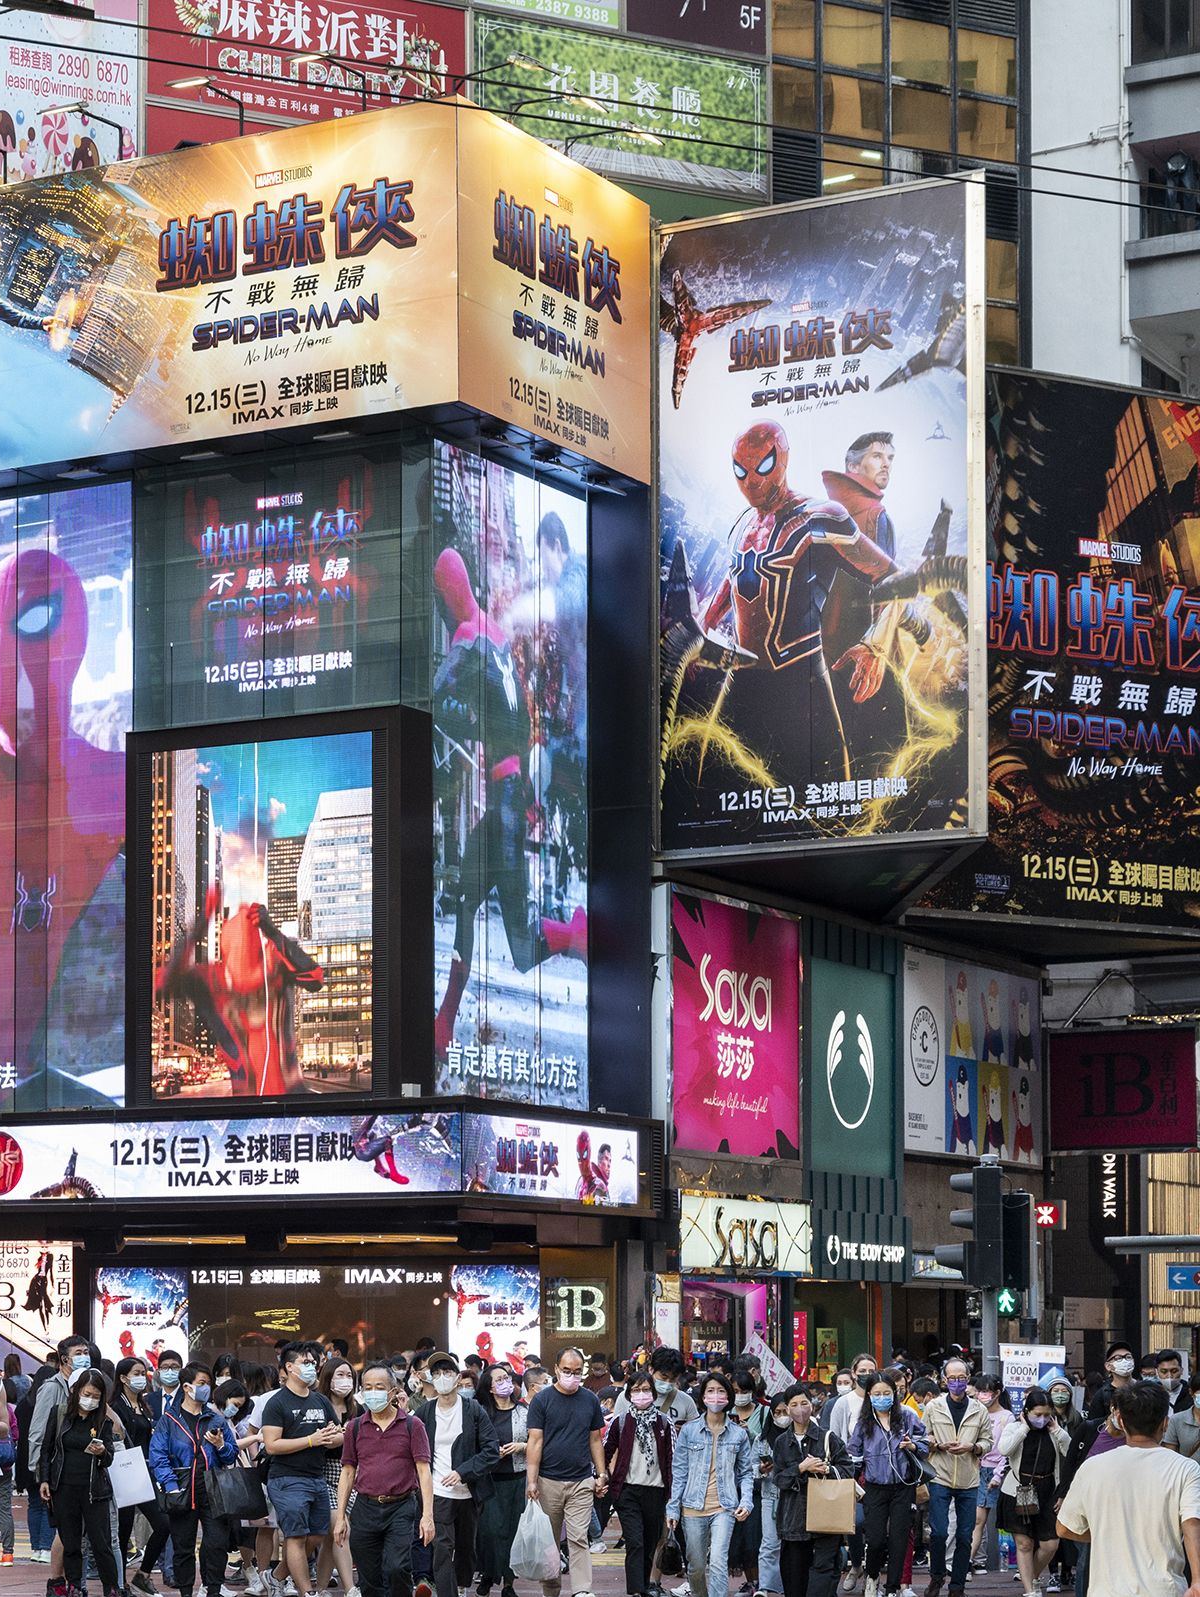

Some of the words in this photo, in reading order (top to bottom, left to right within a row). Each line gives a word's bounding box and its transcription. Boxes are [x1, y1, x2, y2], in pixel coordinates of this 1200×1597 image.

[536, 0, 570, 15] 2387
[575, 4, 609, 23] 9388
[740, 6, 762, 30] 5F
[217, 0, 409, 66] 麻辣派對
[9, 46, 52, 72] 租務查詢
[58, 54, 90, 79] 2890
[97, 62, 129, 85] 6870
[218, 47, 300, 88] CHILI
[307, 63, 407, 104] PARTY
[5, 71, 132, 107] leasing@winnings.com.hk
[726, 76, 749, 90] 4/F
[255, 171, 283, 189] MARVEL
[284, 165, 312, 183] STUDIOS
[156, 176, 419, 292] 蜘蛛俠
[492, 188, 622, 326] 蜘蛛俠
[204, 264, 367, 314] 不戰無歸
[519, 282, 599, 341] 不戰無歸
[244, 350, 260, 366] No
[264, 343, 290, 361] Way
[728, 308, 894, 373] 蜘蛛俠
[540, 358, 549, 372] No
[549, 362, 564, 380] Way
[759, 359, 862, 386] 不戰無歸
[185, 380, 267, 415] 12.15(三)
[277, 361, 388, 401] 全球矚目獻映
[509, 376, 552, 417] 12.15(三)
[232, 406, 285, 426] IMAX
[289, 396, 338, 417] 同步上映
[533, 413, 561, 437] IMAX
[562, 425, 587, 448] 同步上映
[197, 507, 365, 569] 蜘蛛俠
[1079, 538, 1110, 558] MARVEL
[1111, 542, 1141, 564] STUDIOS
[209, 557, 350, 594] 不戰無歸
[244, 624, 259, 638] No
[239, 679, 277, 692] IMAX
[1023, 669, 1197, 717] 不戰無歸
[1067, 757, 1086, 777] No
[1089, 756, 1118, 779] Way
[719, 785, 796, 812] 12.15(三)
[805, 776, 908, 806] 全球矚目獻映
[762, 808, 812, 824] IMAX
[816, 803, 862, 819] 同步上映
[1021, 854, 1100, 886] 12.15(三)
[1066, 886, 1115, 904] IMAX
[1119, 891, 1164, 908] 同步上映
[446, 1039, 578, 1089] 肯定還有其他方法
[717, 1032, 754, 1081] 莎莎
[1159, 1051, 1179, 1116] 金百利
[1123, 1118, 1179, 1129] BEVERLEY
[110, 1135, 210, 1168] 12.15(三)
[496, 1137, 559, 1178] 蜘蛛俠
[168, 1170, 231, 1187] IMAX
[239, 1168, 300, 1186] 同步上映
[1103, 1177, 1116, 1218] WALK
[7, 1258, 29, 1268] 6870
[842, 1242, 857, 1259] THE
[860, 1243, 882, 1261] BODY
[883, 1245, 905, 1263] SHOP
[56, 1254, 72, 1318] 金百利
[345, 1269, 402, 1284] IMAX
[1006, 1366, 1037, 1376] 1000M
